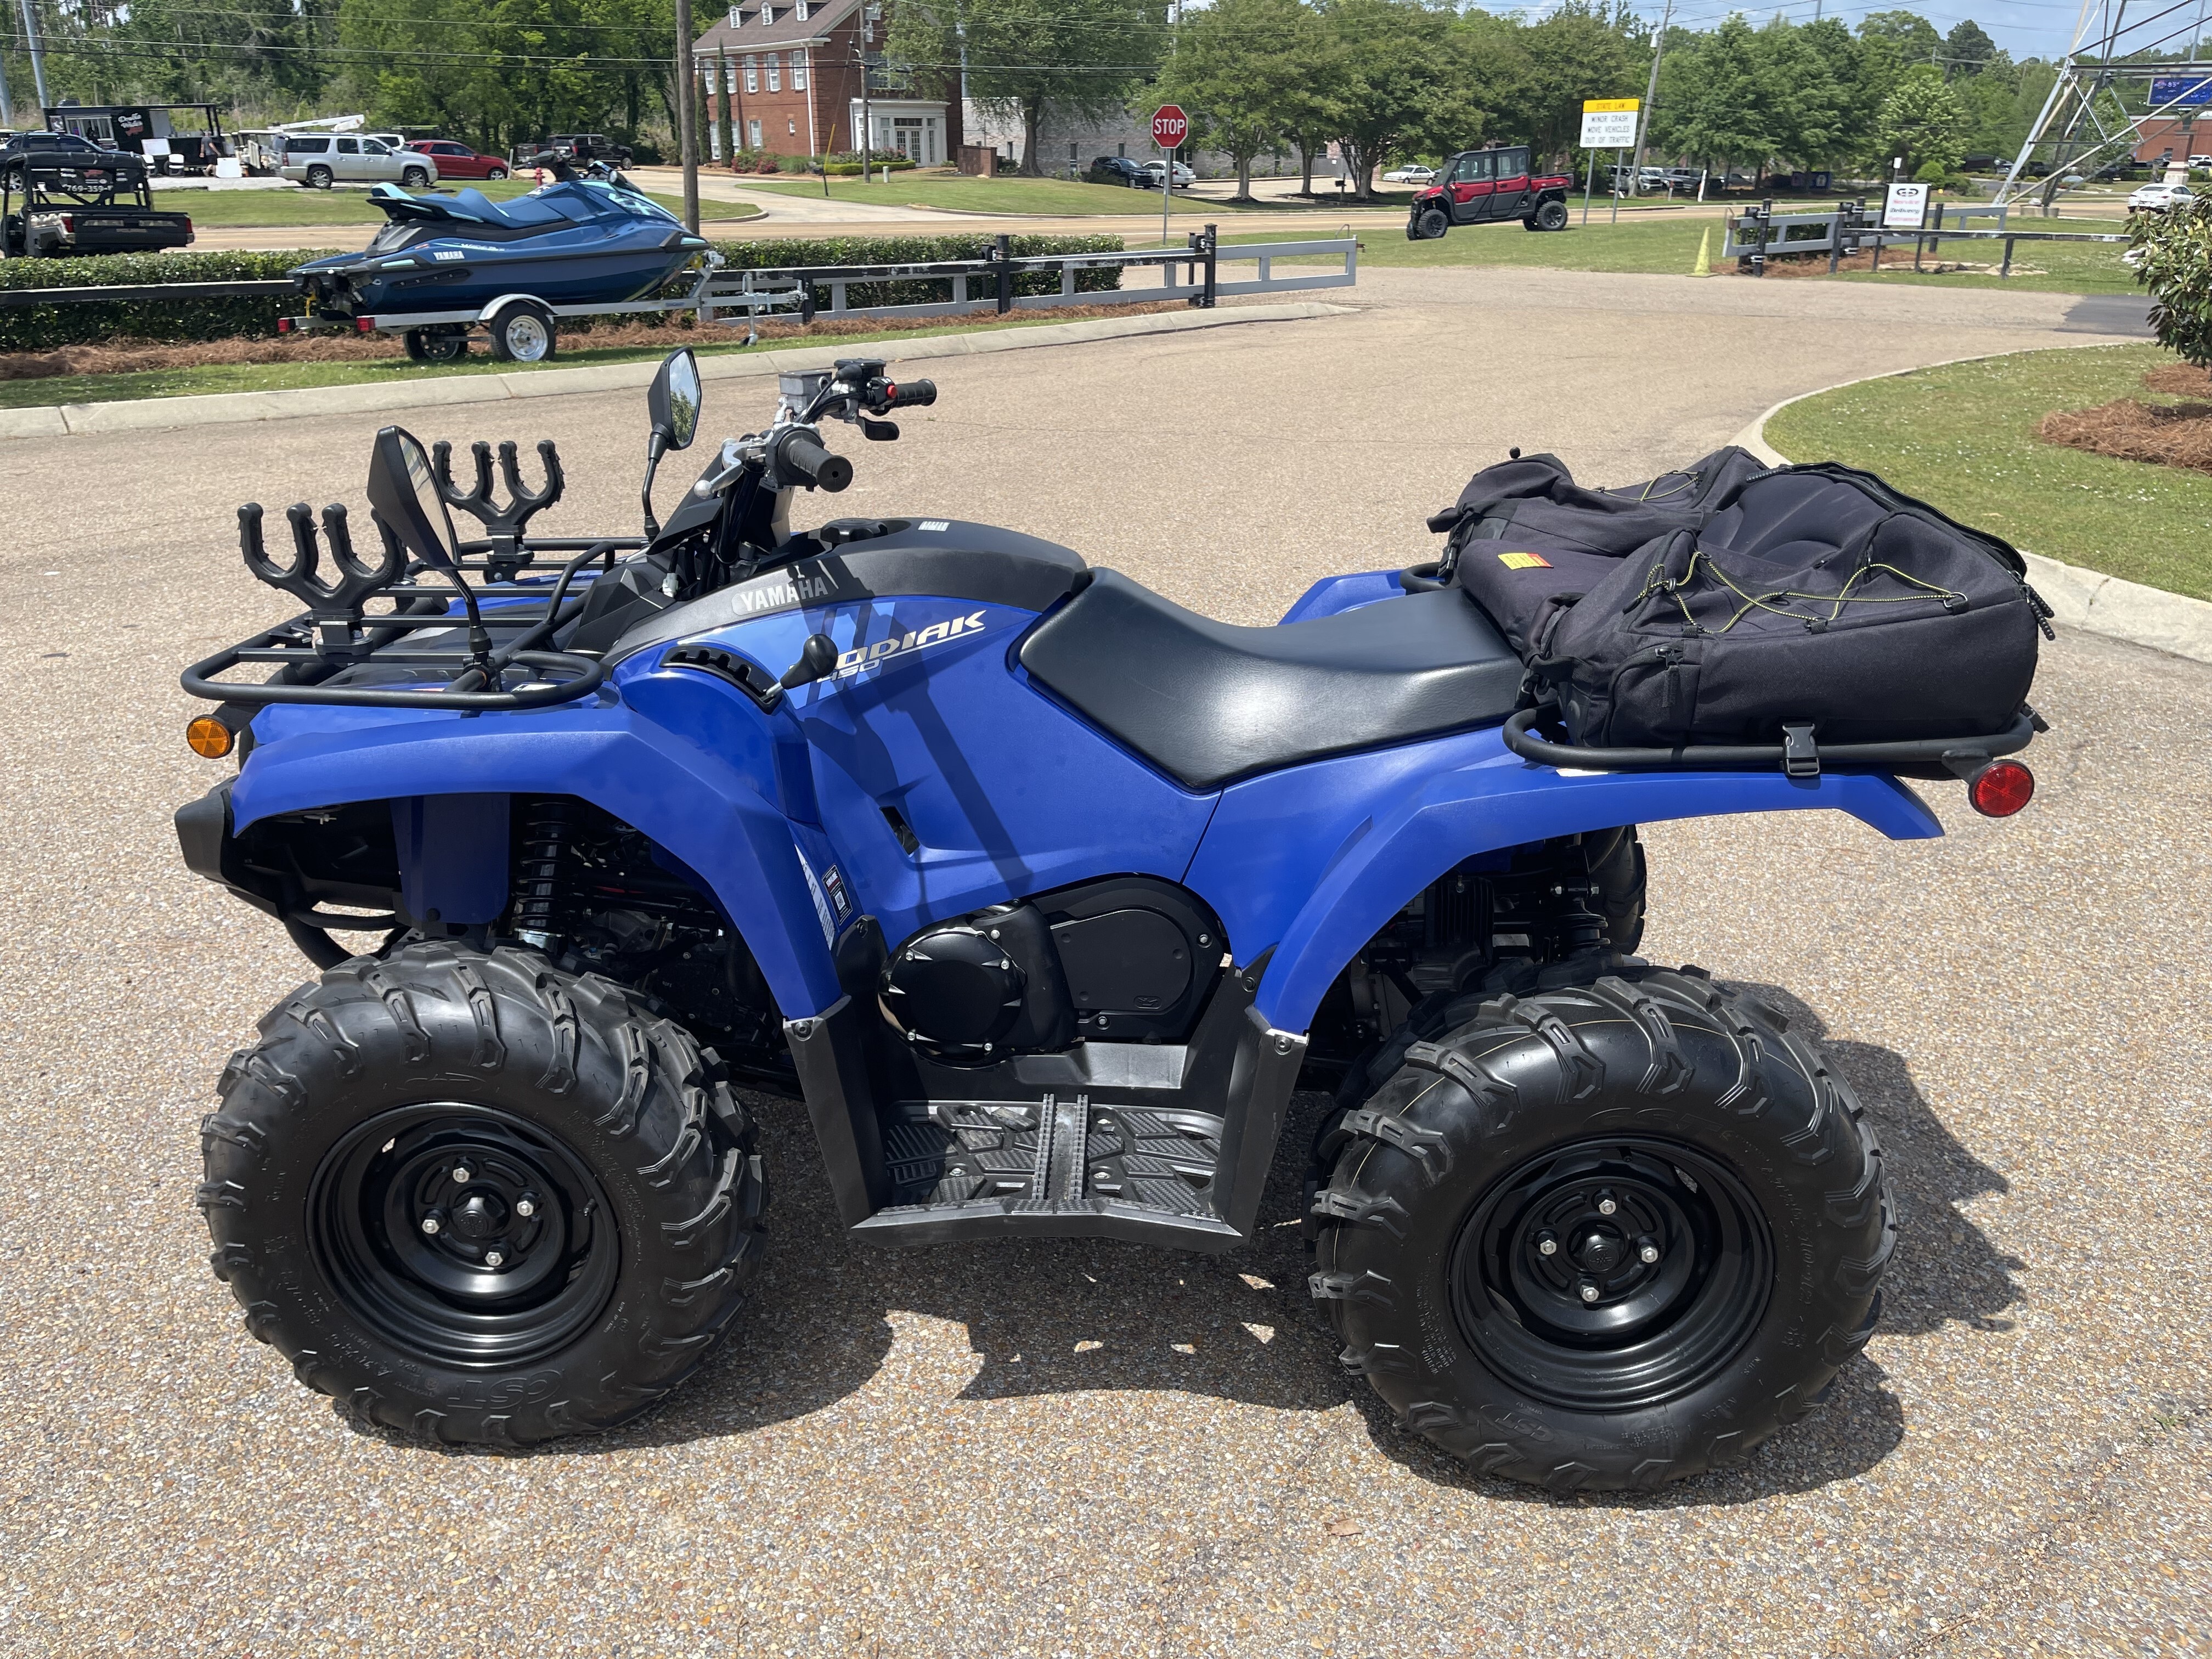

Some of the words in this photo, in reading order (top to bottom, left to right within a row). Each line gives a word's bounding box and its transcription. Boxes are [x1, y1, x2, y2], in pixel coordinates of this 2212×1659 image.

[1154, 119, 1185, 134] STOP
[740, 577, 828, 612] YAMAHA
[788, 610, 987, 671] ODIAK
[816, 658, 882, 683] 450
[447, 1369, 561, 1410] CST
[1494, 1412, 1555, 1443] CST
